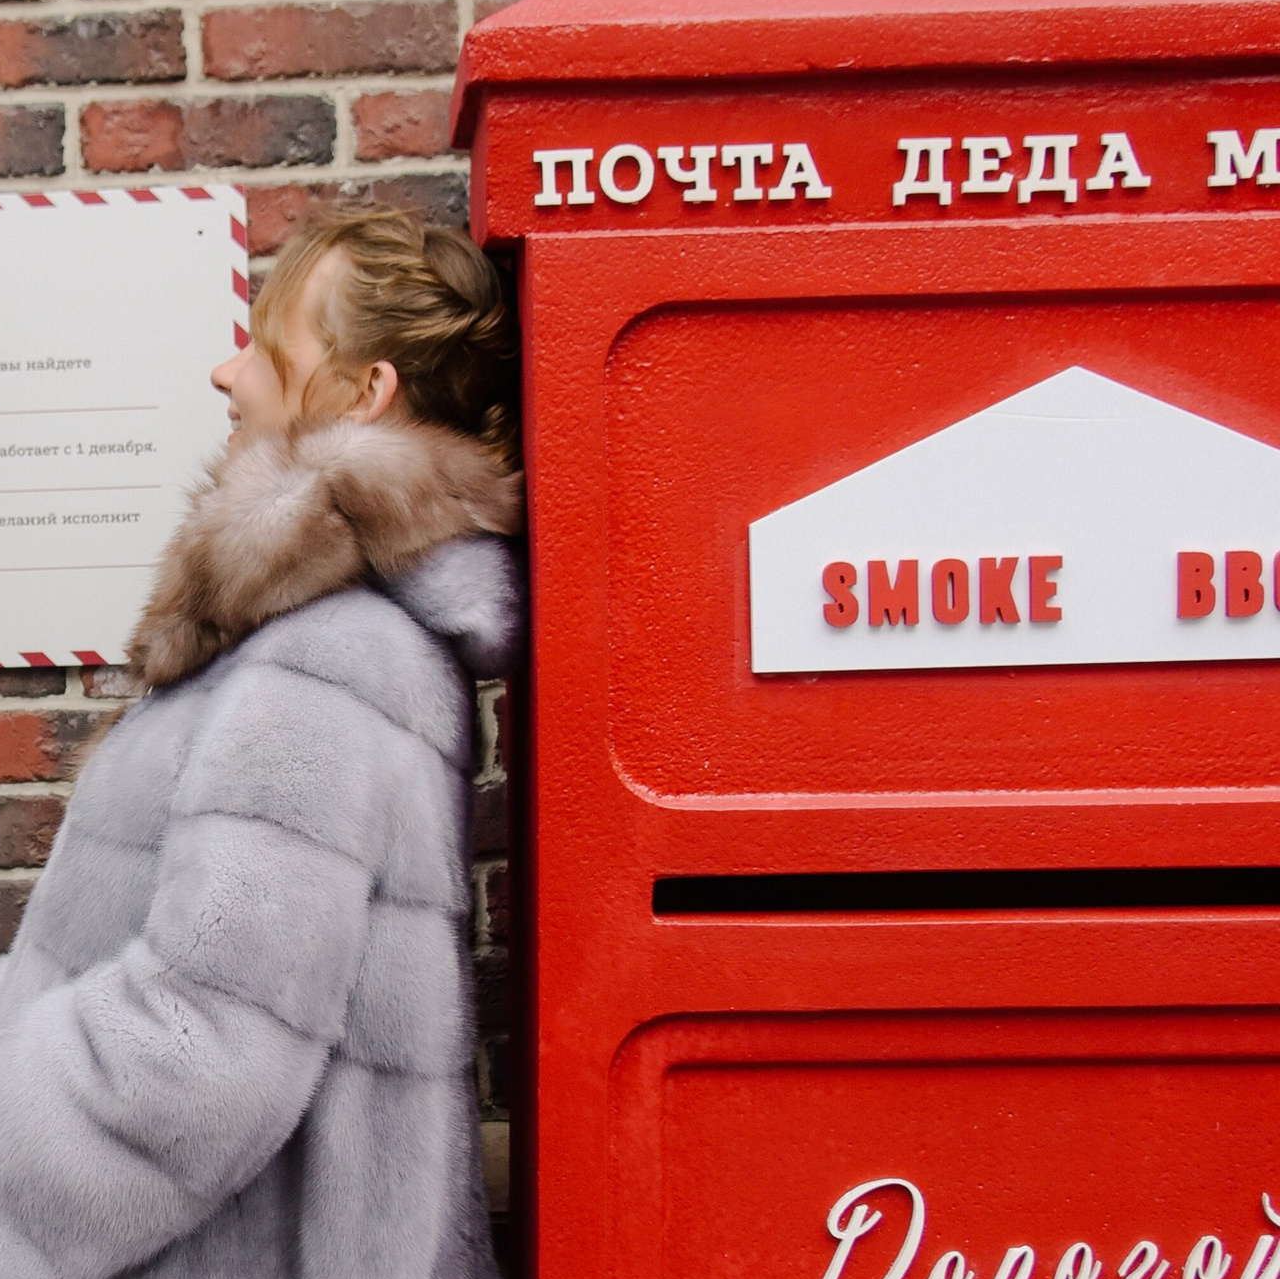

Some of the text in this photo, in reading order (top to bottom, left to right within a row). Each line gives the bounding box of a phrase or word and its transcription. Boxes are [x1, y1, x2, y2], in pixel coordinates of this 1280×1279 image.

[533, 142, 833, 207] ПОЧТА
[893, 132, 1152, 206] ДЕДА
[0, 361, 21, 373] вы
[26, 356, 92, 372] найдете
[63, 443, 72, 455] с
[76, 442, 84, 455] 1
[88, 439, 158, 459] декабря.
[62, 511, 141, 525] исполнит
[822, 550, 1280, 628] SMOKE BB
